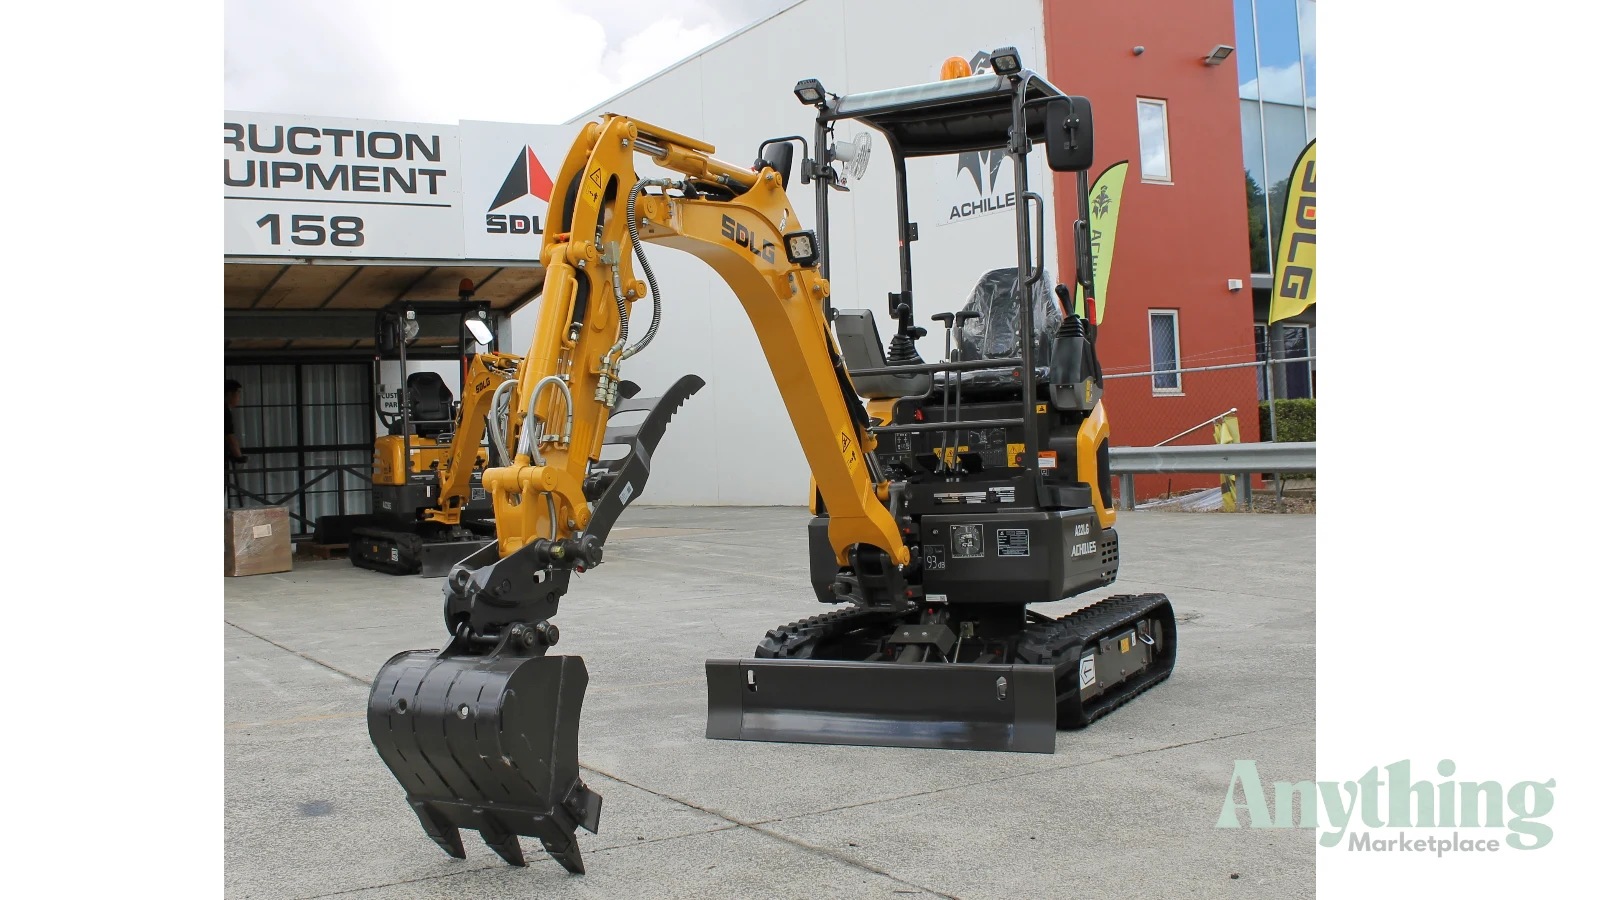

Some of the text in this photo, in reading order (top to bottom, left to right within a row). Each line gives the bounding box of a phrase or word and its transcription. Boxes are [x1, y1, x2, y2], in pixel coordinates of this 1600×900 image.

[224, 122, 441, 162] RUCTION
[224, 159, 446, 195] UIPMENT
[950, 191, 1016, 220] ACHILLE
[256, 213, 365, 247] 158
[721, 213, 775, 265] SDLG
[475, 377, 491, 393] SDLG
[926, 555, 937, 569] 93
